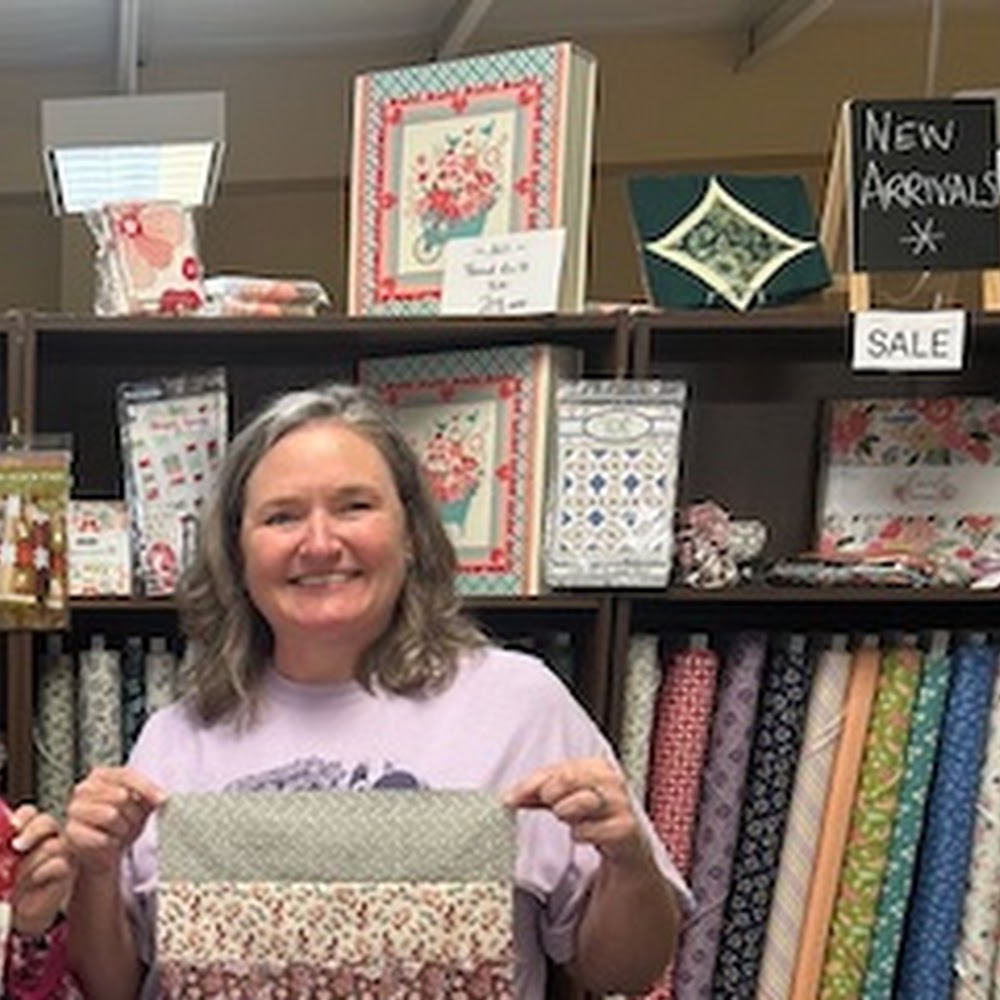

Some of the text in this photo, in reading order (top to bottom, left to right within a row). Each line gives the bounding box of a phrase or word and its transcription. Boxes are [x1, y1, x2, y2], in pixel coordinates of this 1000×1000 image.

[865, 108, 955, 154] NEW
[860, 160, 1000, 210] ARRIVALS
[867, 327, 951, 359] SALE
